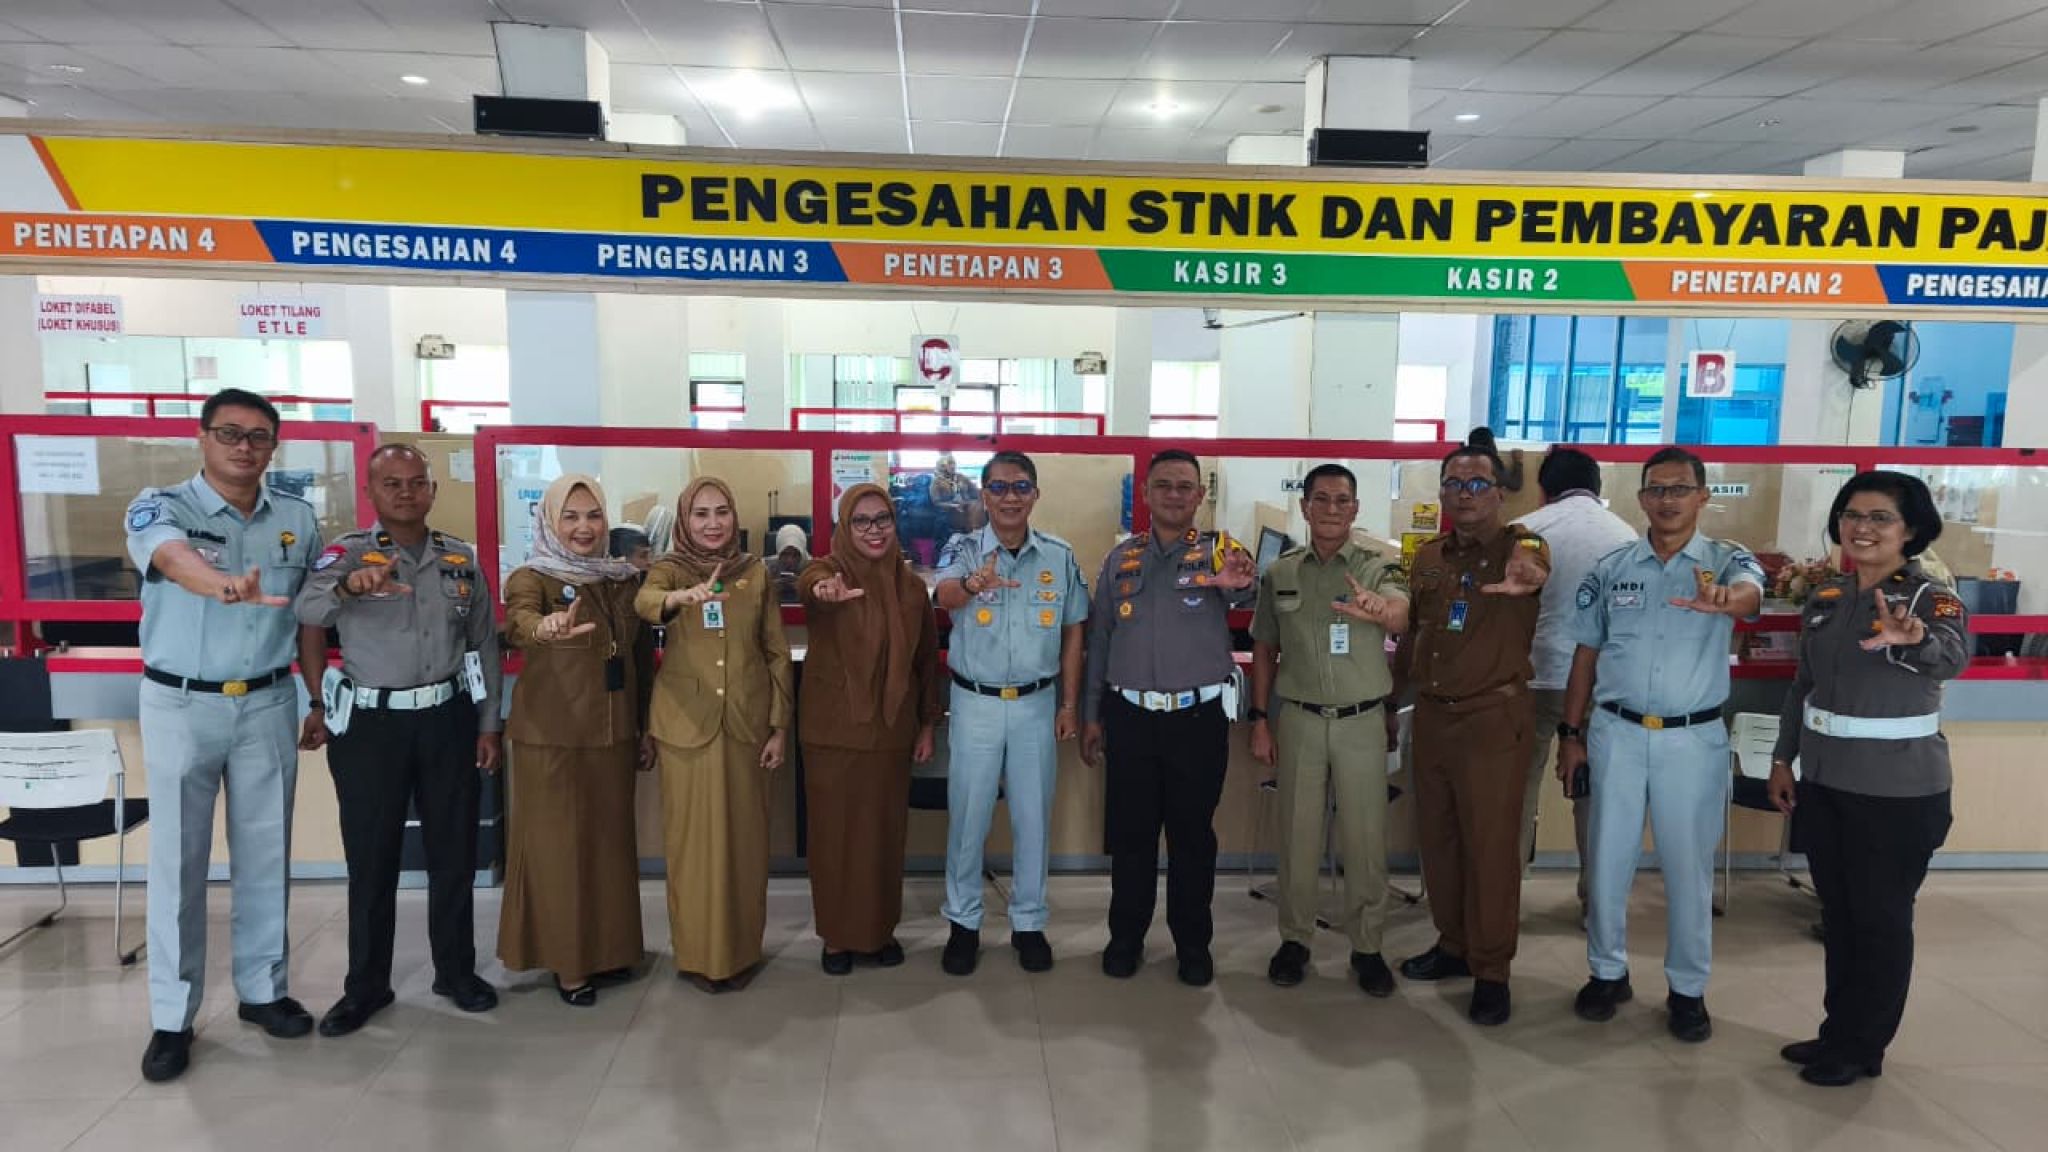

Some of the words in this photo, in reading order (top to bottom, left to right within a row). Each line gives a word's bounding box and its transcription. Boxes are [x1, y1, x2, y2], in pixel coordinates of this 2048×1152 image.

[641, 173, 1107, 232] PENGESAHAN
[1127, 189, 1298, 238] STNK
[1320, 194, 1454, 241] DAN
[1475, 198, 1921, 249] PEMBAYARAN
[1938, 207, 2048, 252] PAJ
[13, 222, 189, 251] PENETAPAN
[197, 227, 216, 252] 4
[291, 230, 492, 263] PENGESAHAN
[499, 239, 518, 264] 4
[597, 243, 785, 273] PENGESAHAN
[793, 250, 809, 274] 3
[884, 252, 1041, 280] PENETAPAN
[1048, 256, 1063, 280] 3
[1173, 260, 1262, 286] KASIR
[1271, 263, 1288, 286] 3
[1446, 266, 1534, 292] KASIR
[1542, 267, 1559, 292] 2
[1671, 269, 1822, 295] PENETAPAN
[1826, 272, 1843, 296] 2
[40, 301, 73, 314] LOKET
[75, 302, 117, 315] DIFABEL
[240, 304, 277, 317] LOKET
[280, 304, 321, 318] TILANG
[919, 338, 952, 381] C
[1694, 353, 1726, 394] B
[1711, 485, 1744, 494] ASIR
[1611, 581, 1644, 591] ANDI
